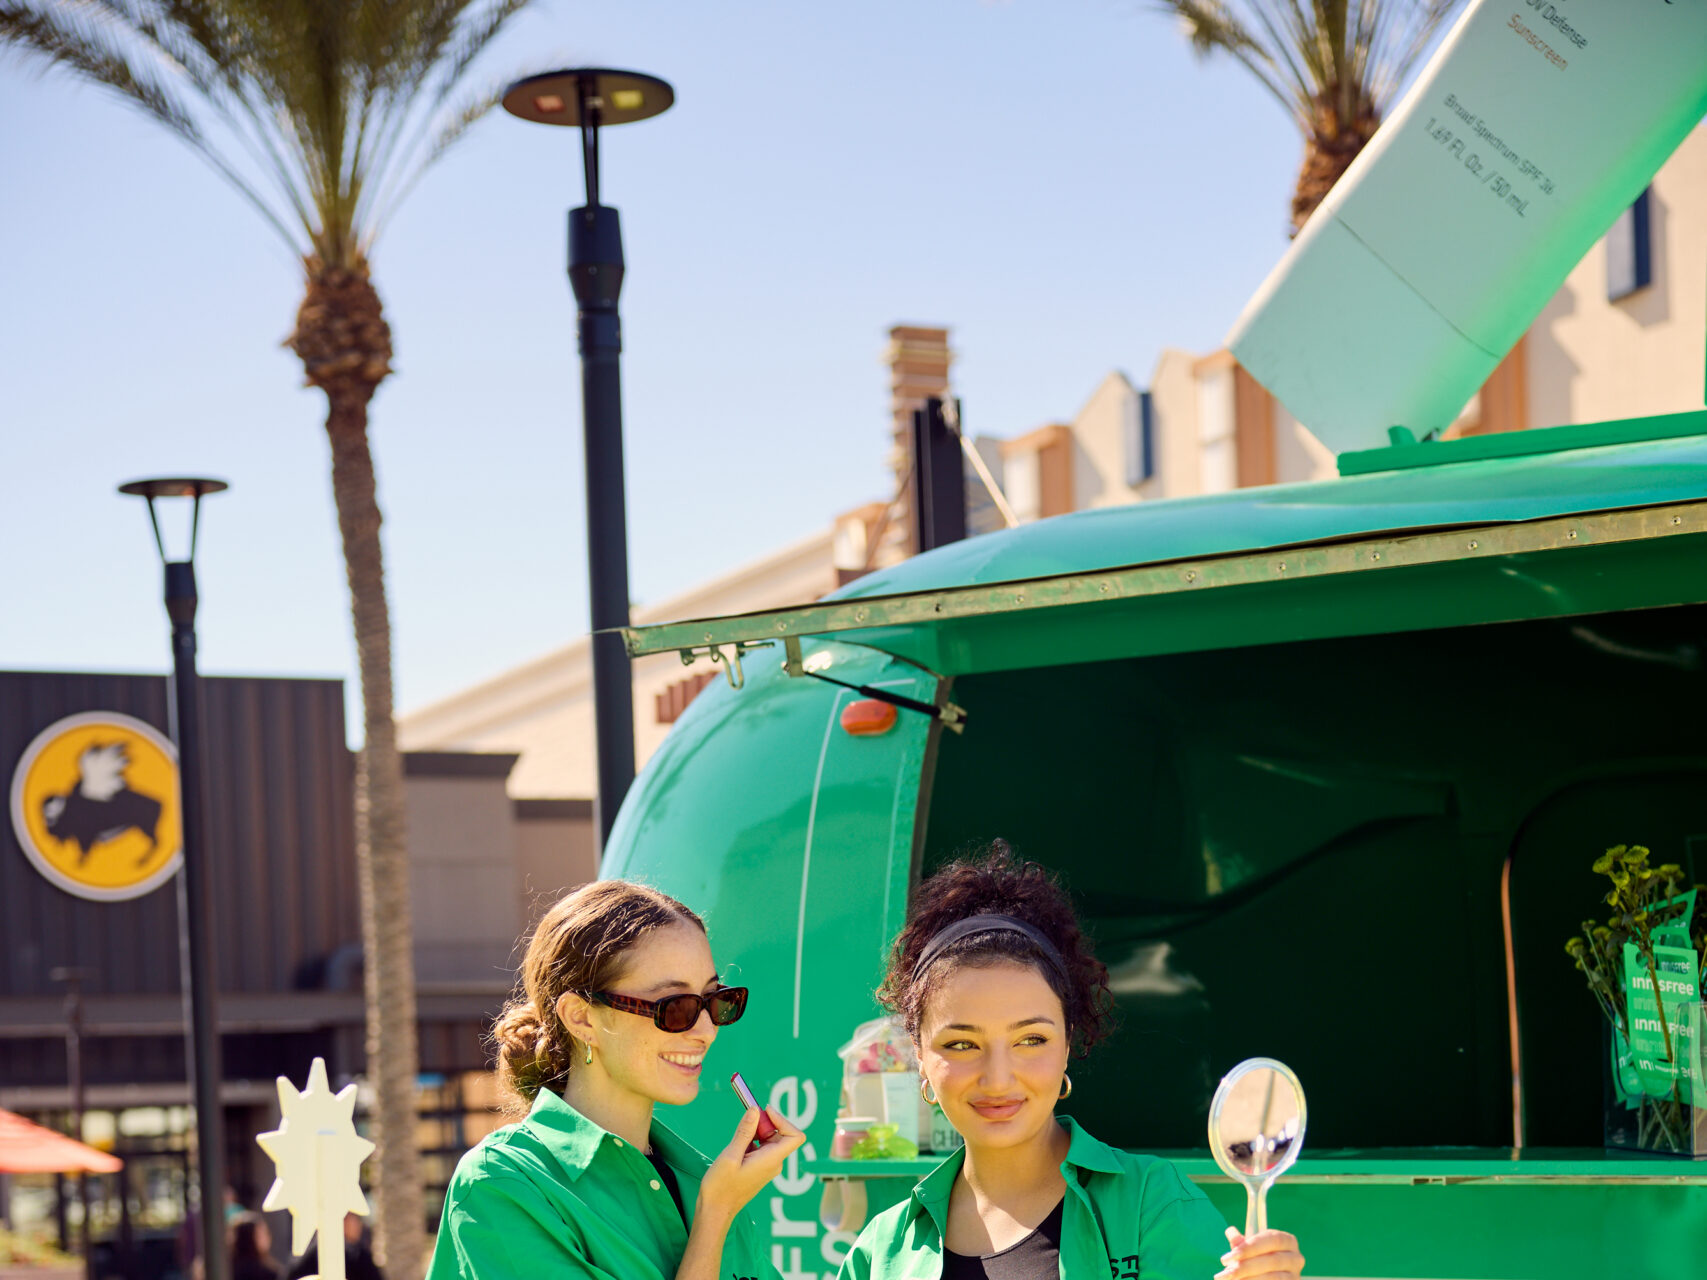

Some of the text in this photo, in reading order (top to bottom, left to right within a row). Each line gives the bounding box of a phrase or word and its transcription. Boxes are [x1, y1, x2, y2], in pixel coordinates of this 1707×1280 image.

[1507, 13, 1568, 71] Sunscreen
[1542, 5, 1588, 49] Defense
[1444, 94, 1475, 124] Broad
[1473, 115, 1520, 166] Spectrum
[1518, 159, 1543, 183] SPF
